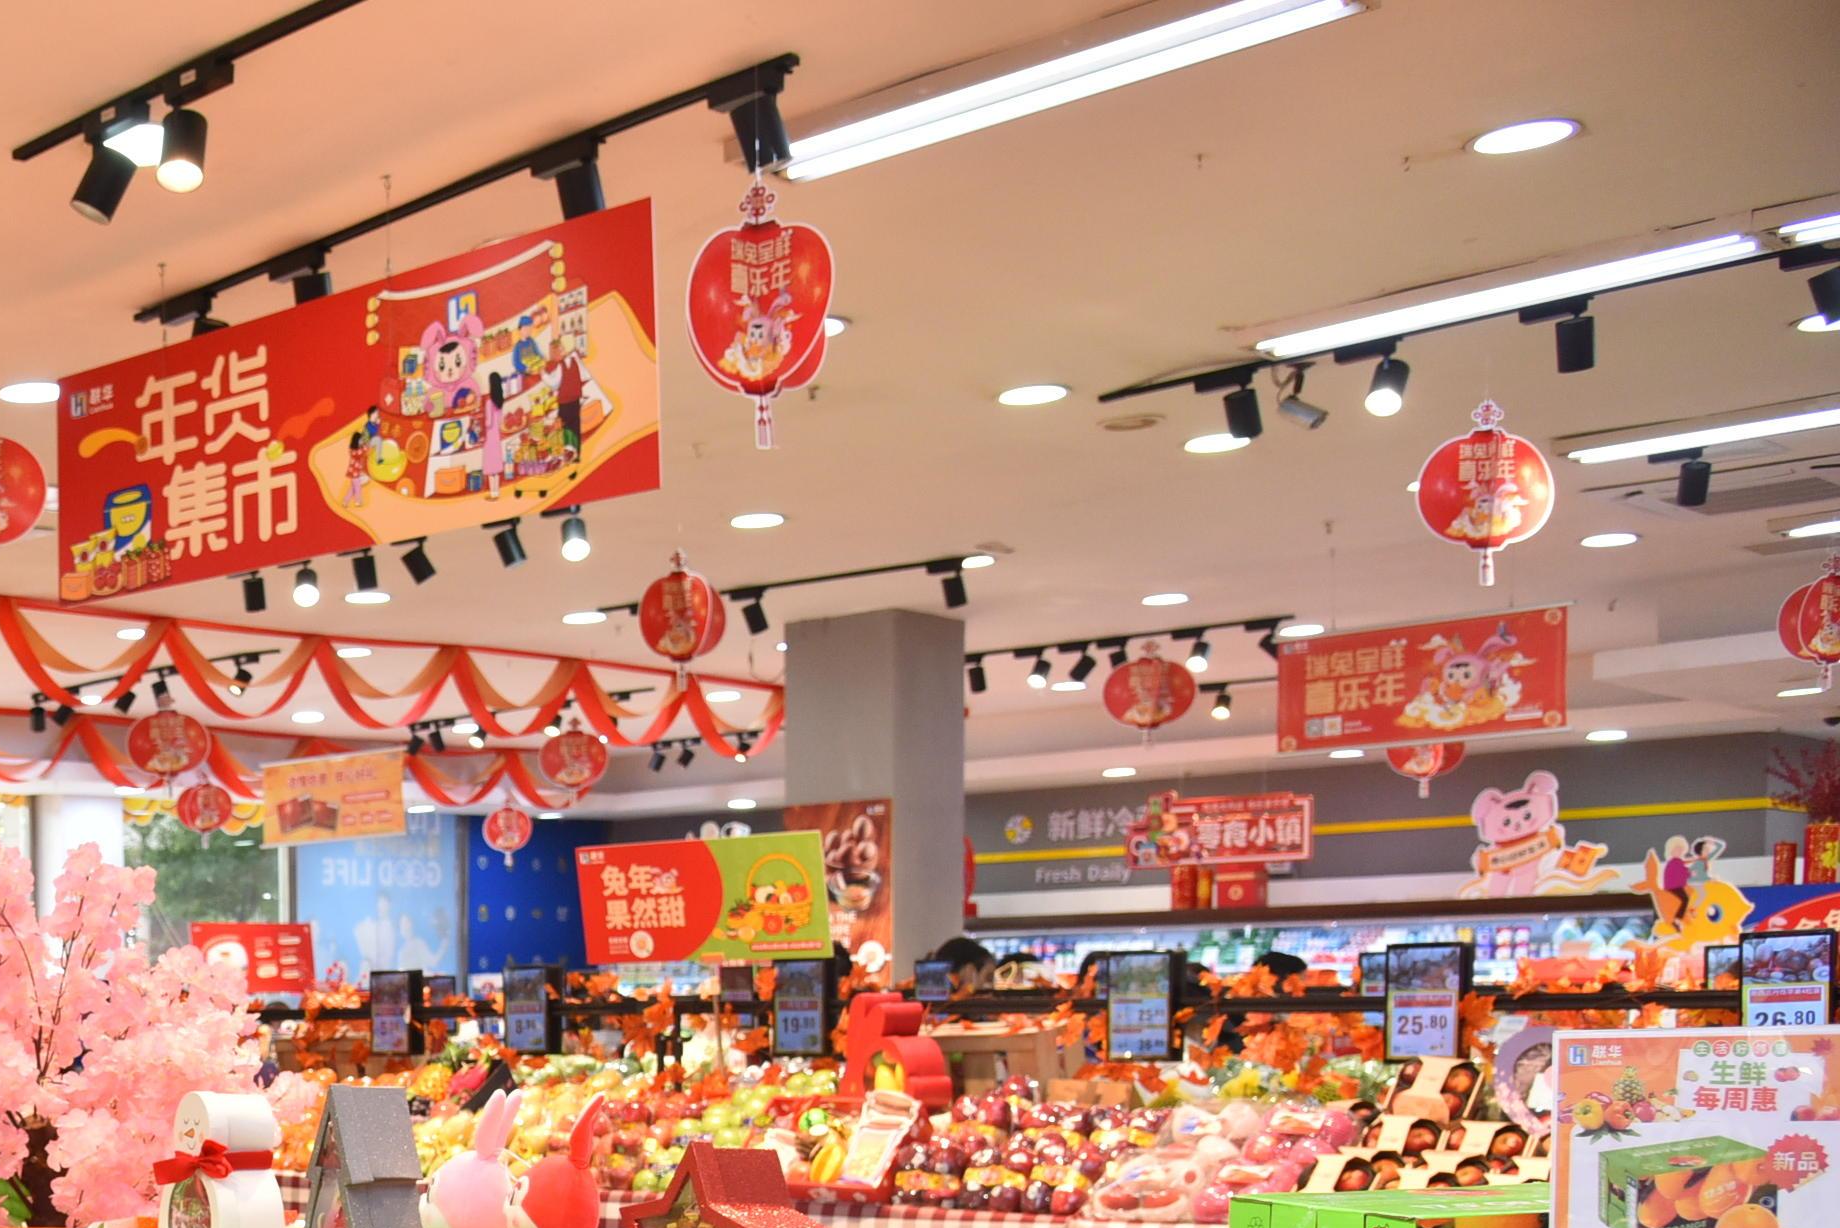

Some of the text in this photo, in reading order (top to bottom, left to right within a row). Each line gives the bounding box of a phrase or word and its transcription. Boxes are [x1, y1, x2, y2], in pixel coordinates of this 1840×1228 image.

[135, 345, 271, 465] 年货
[162, 448, 298, 560] 集市
[600, 865, 654, 897] 兔年
[1035, 864, 1133, 885] Fresh Daily
[606, 897, 687, 931] 果然甜
[1397, 1015, 1448, 1036] 25.80
[1591, 1045, 1622, 1058] 联华
[1710, 1060, 1768, 1087] 生鲜
[1692, 1086, 1779, 1113] 每周惠
[1773, 1152, 1820, 1172] 新品
